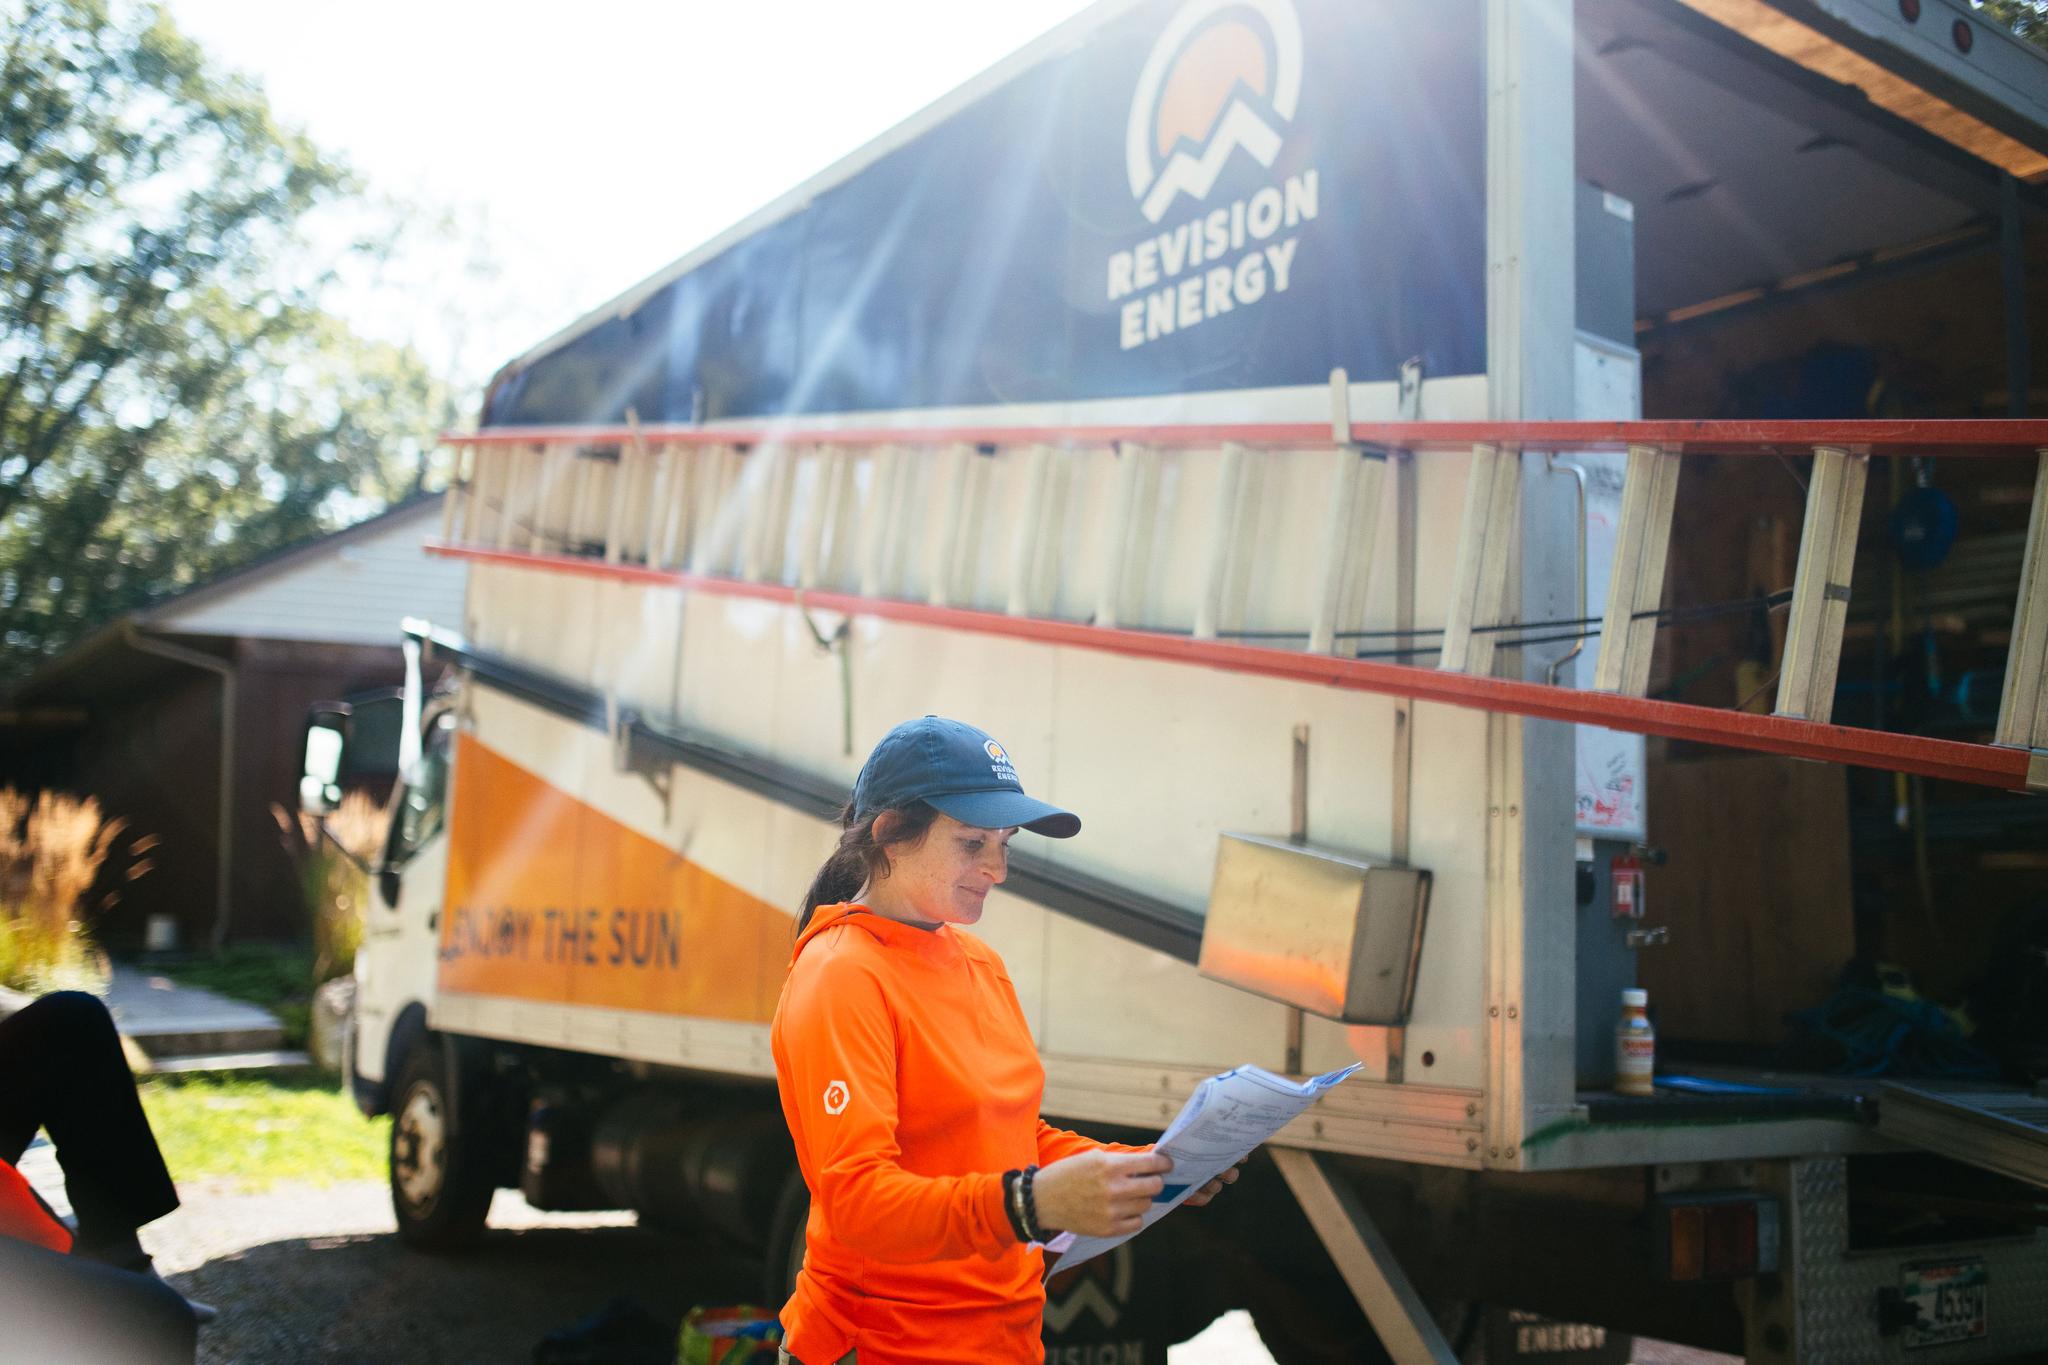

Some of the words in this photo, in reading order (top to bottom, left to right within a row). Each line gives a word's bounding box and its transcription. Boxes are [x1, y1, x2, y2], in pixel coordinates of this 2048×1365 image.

[1107, 168, 1319, 301] REVISION
[1120, 237, 1297, 351] ENERGY
[544, 908, 598, 967] THE
[608, 907, 681, 969] SUN
